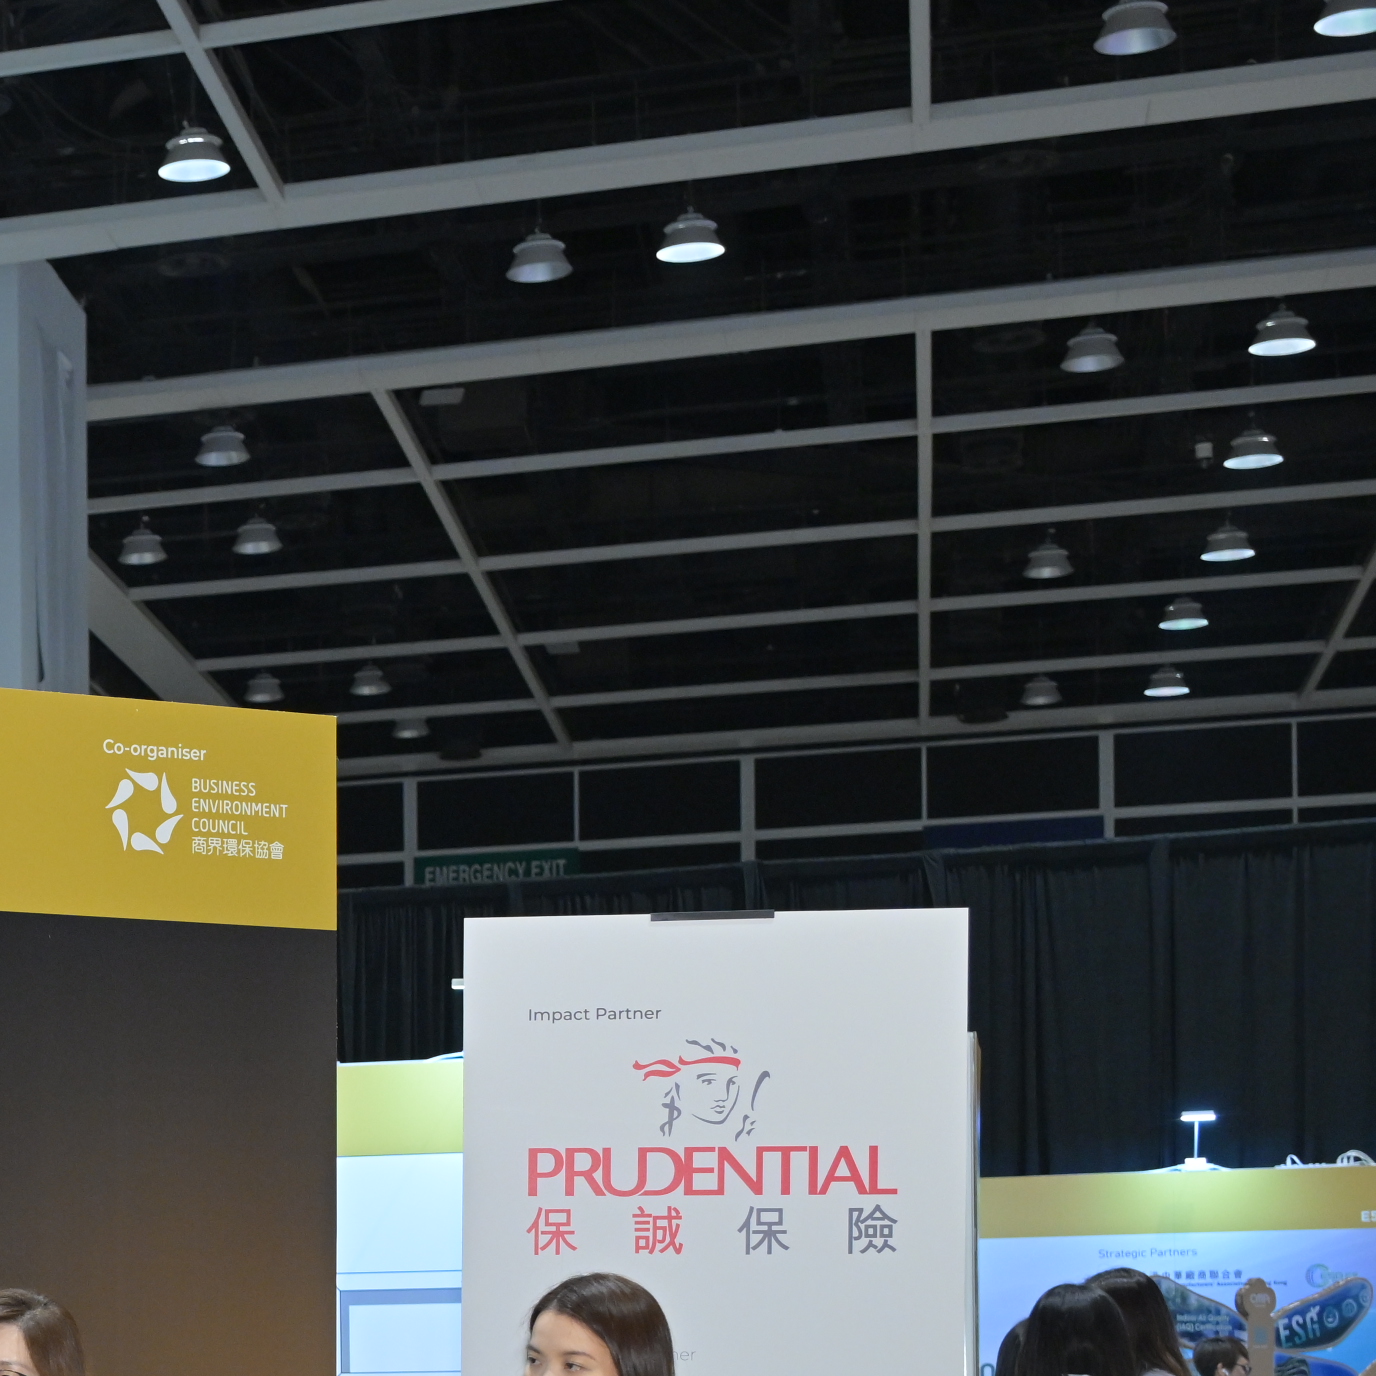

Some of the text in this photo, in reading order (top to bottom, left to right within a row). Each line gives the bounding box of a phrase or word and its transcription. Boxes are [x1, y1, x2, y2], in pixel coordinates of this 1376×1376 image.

[103, 739, 207, 761] Co-organiser
[192, 778, 256, 796] BUSINESS
[192, 798, 288, 818] ENVIRONMENT
[192, 818, 248, 835] COUNCIL
[192, 837, 285, 860] 商界環保協會
[424, 859, 567, 886] EMERGENCY EXIT
[528, 1006, 662, 1024] Impact Partner
[527, 1145, 897, 1197] PRUDENTIAL
[526, 1204, 898, 1256] 保誠保險
[1098, 1248, 1198, 1259] Strategic Partners
